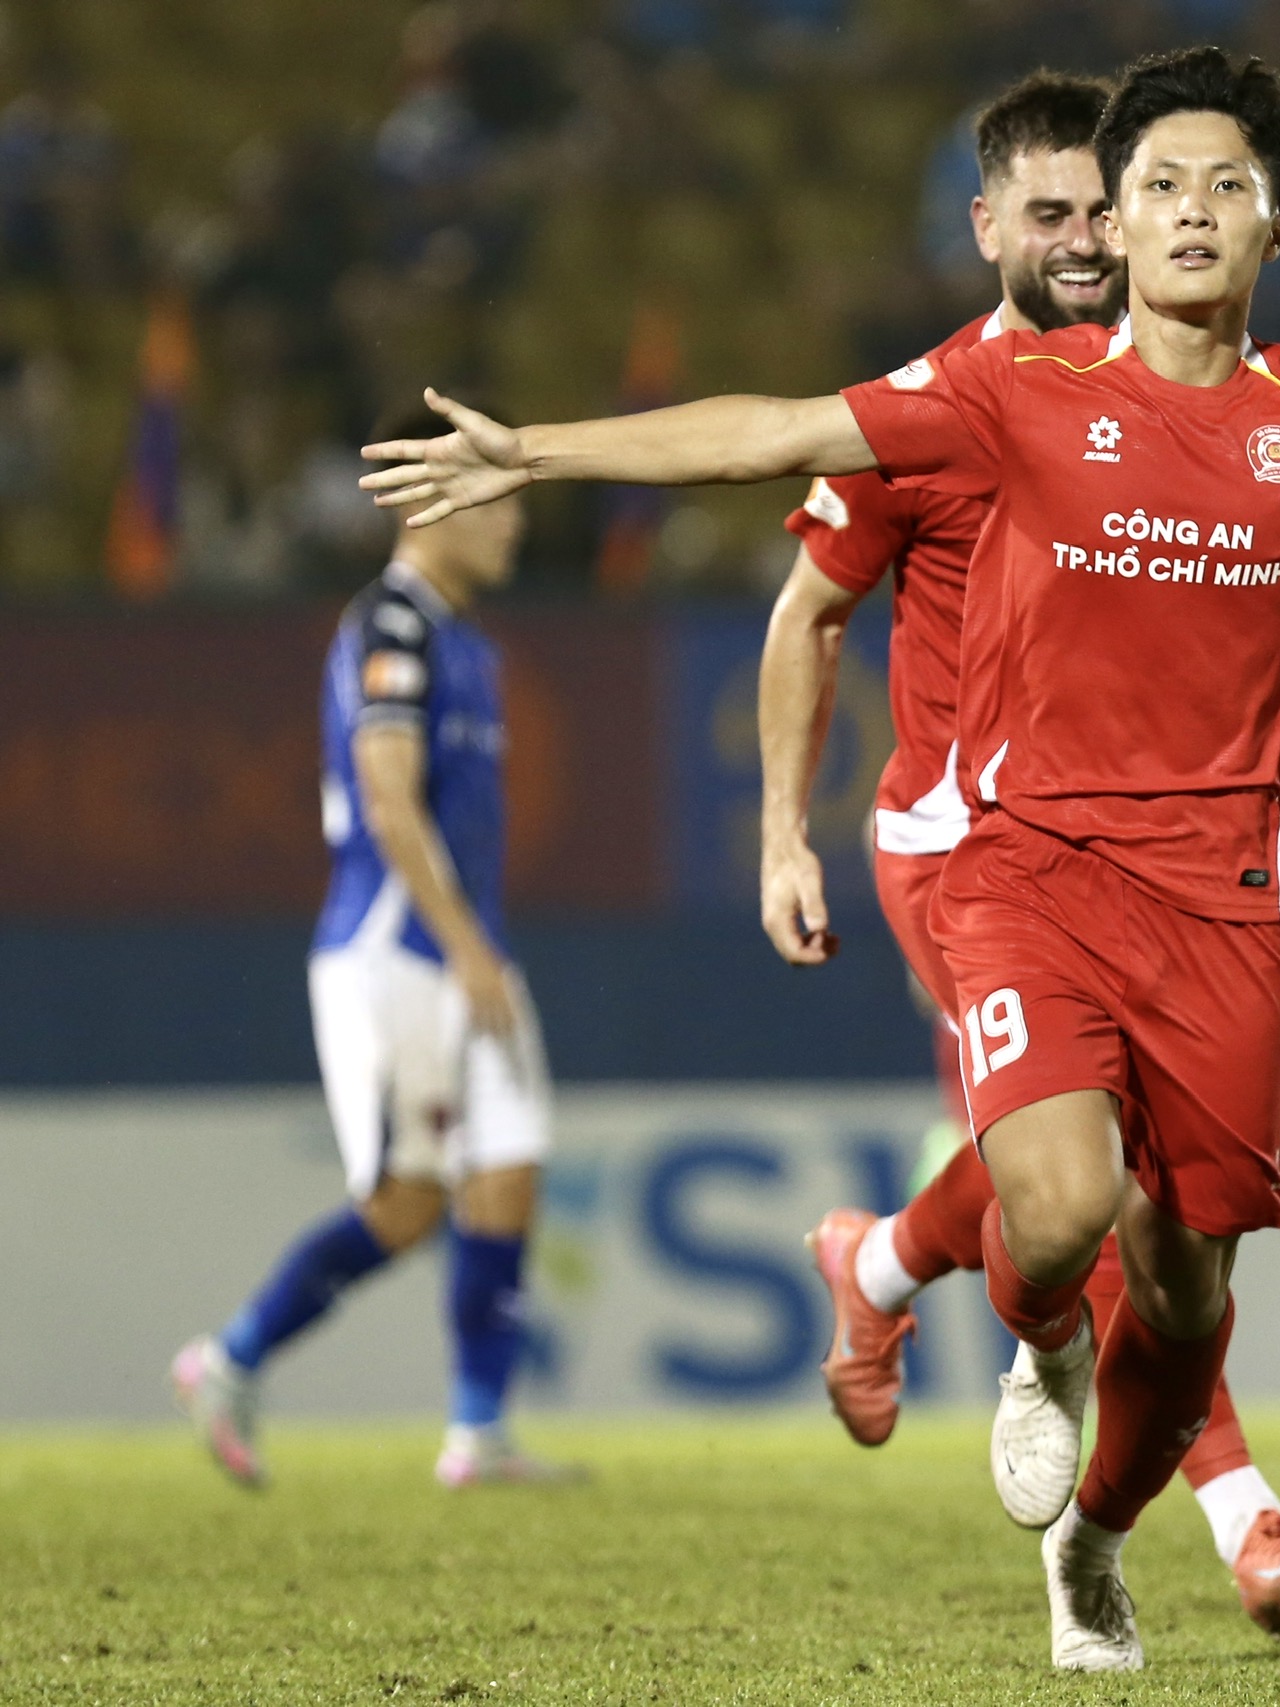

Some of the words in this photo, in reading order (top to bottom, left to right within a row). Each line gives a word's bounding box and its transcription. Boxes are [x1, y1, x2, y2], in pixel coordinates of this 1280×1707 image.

[1102, 507, 1200, 546] CÔNG
[1207, 522, 1254, 550] AN
[1052, 541, 1141, 578] TP.HỒ
[1147, 554, 1209, 584] CHÍ
[964, 987, 1029, 1088] 19
